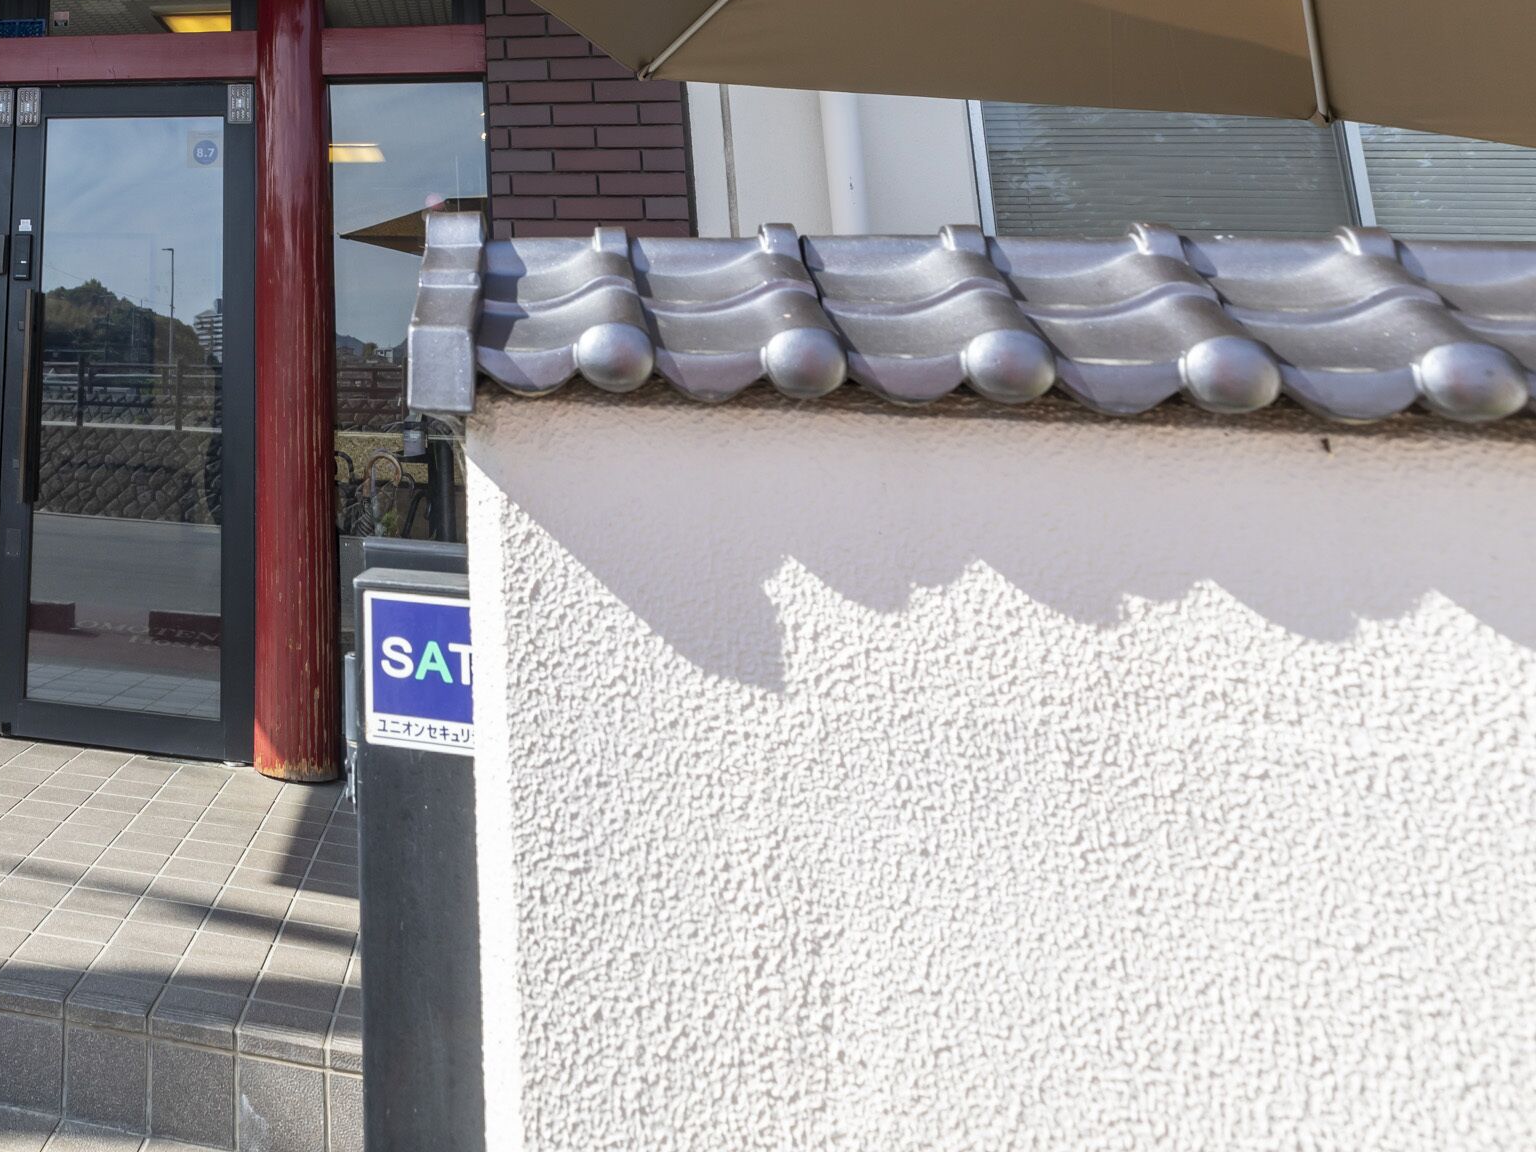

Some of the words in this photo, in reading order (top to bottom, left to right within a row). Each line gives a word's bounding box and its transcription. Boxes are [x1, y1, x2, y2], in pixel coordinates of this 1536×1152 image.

[196, 147, 215, 158] 8.7
[377, 719, 474, 744] ユニオンセキュリ
